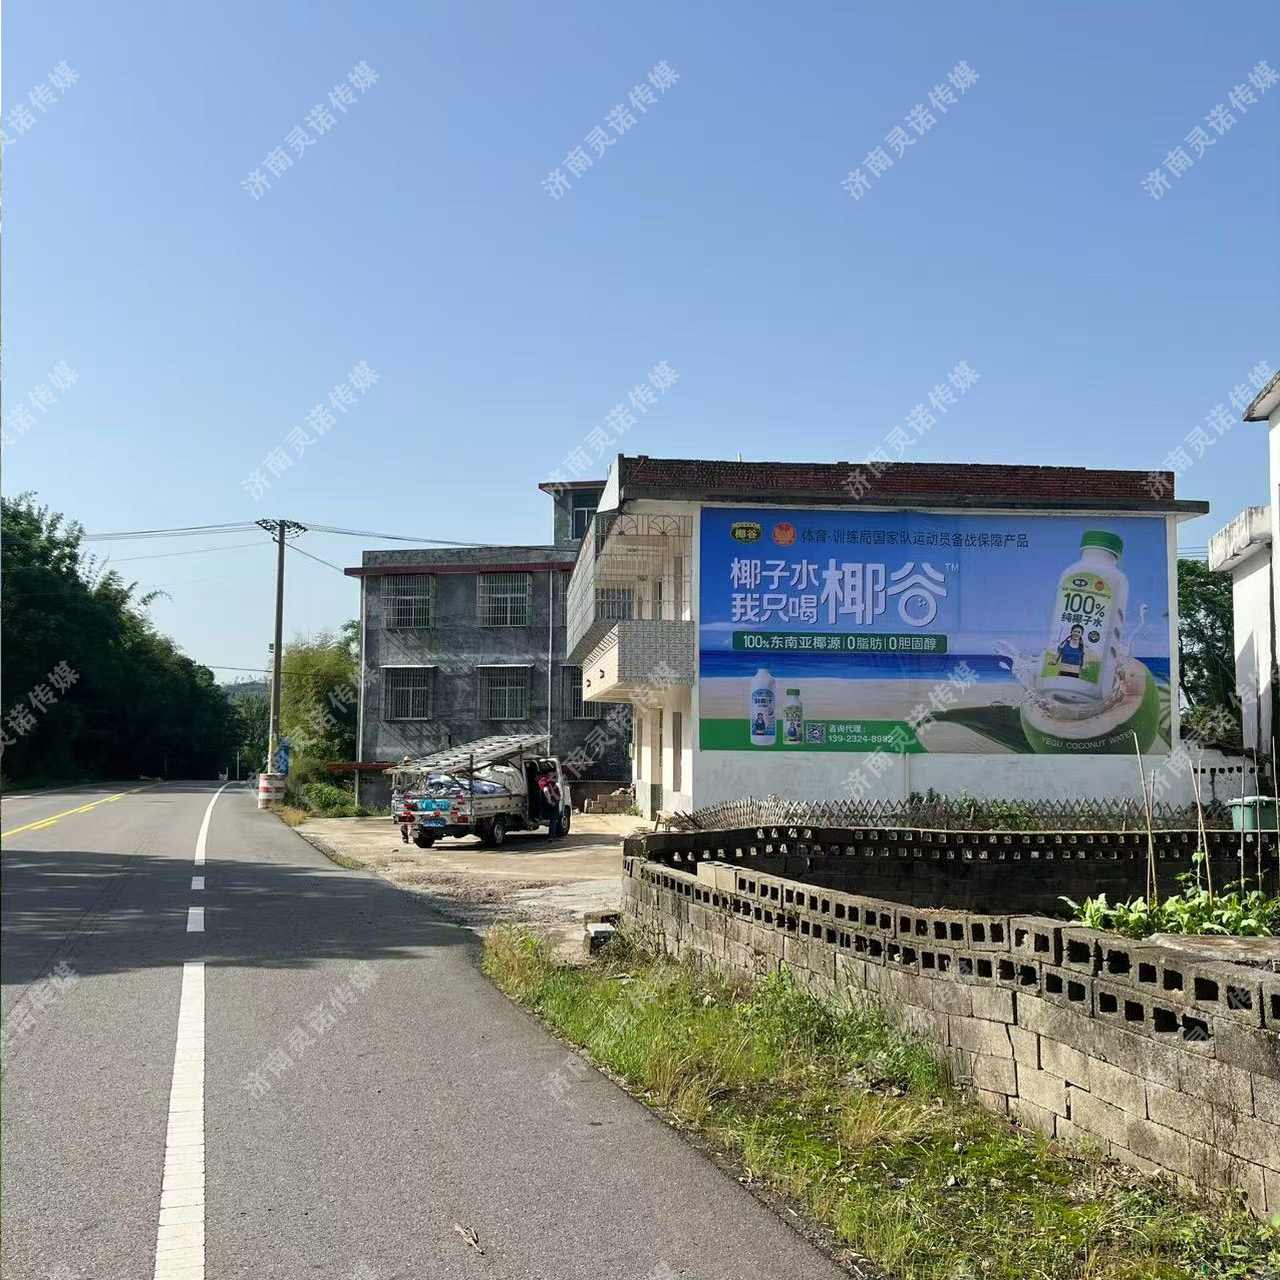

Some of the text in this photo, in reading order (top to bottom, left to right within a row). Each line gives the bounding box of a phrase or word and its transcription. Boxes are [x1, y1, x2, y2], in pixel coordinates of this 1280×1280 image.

[730, 557, 820, 590] 椰子水
[821, 558, 948, 627] 椰谷
[1064, 593, 1106, 618] 100%
[731, 593, 818, 624] 我只喝
[1061, 612, 1103, 628] 纯椰子水
[1066, 739, 1106, 750] COCONUT
